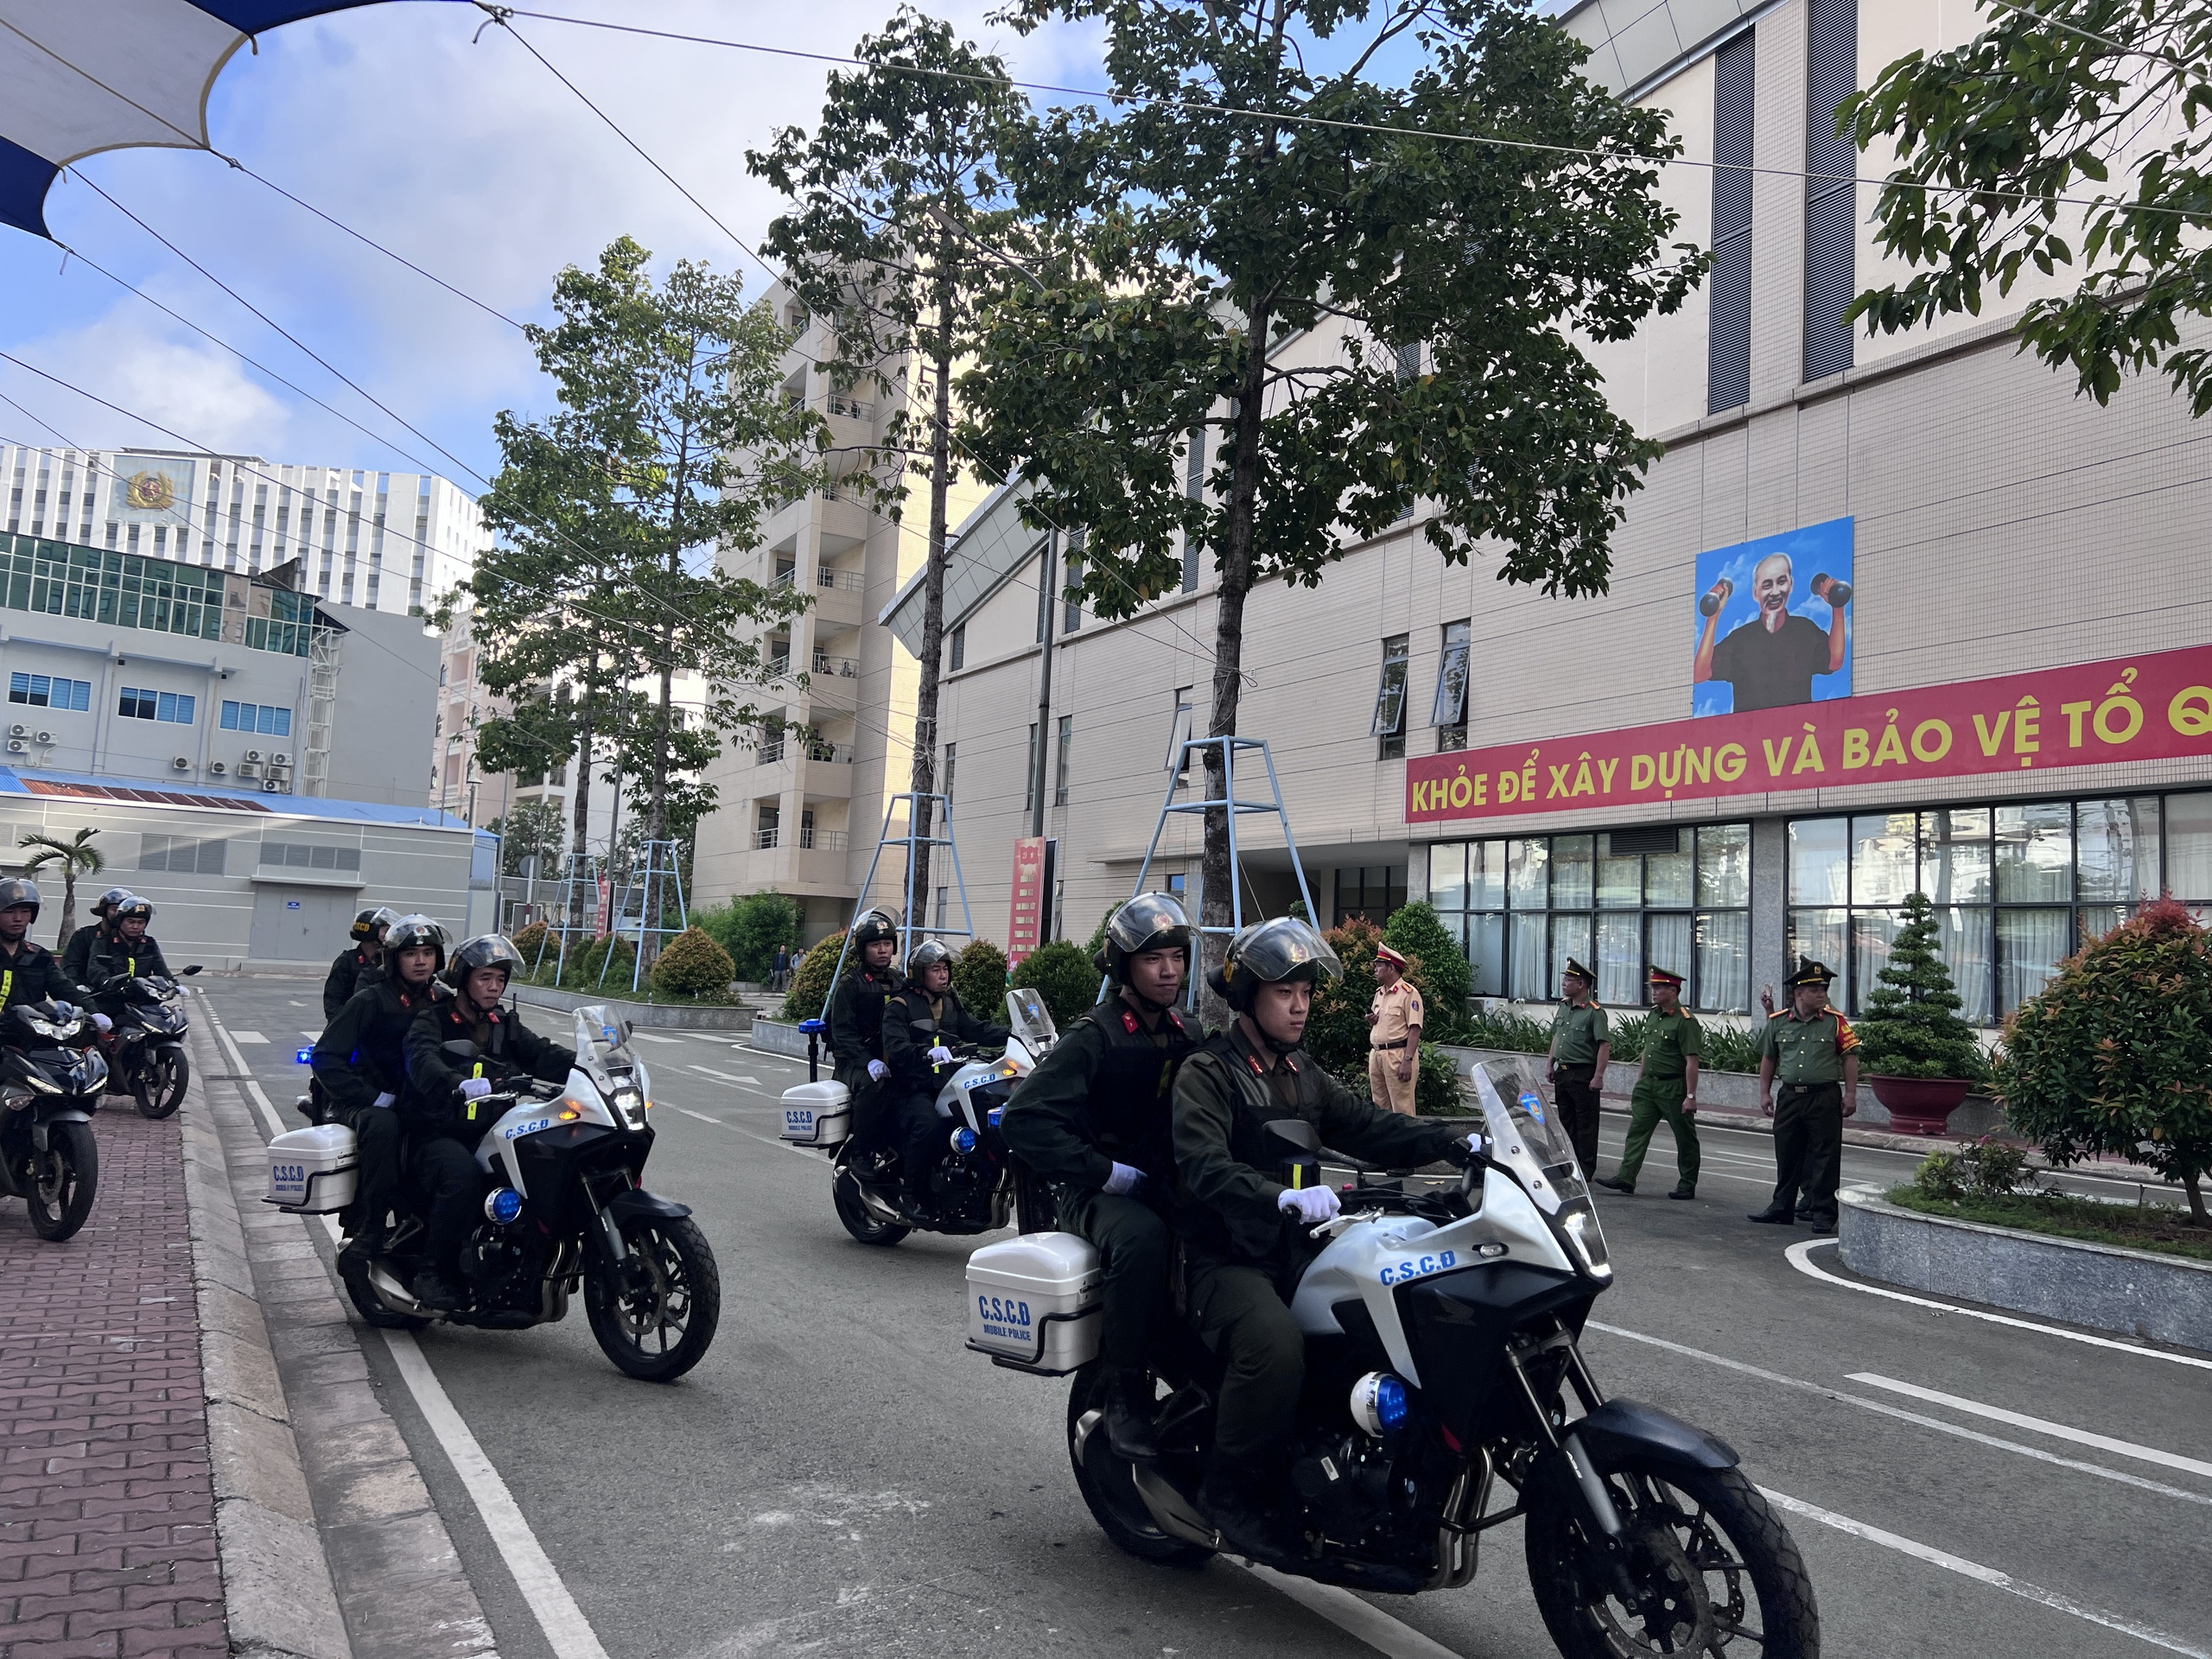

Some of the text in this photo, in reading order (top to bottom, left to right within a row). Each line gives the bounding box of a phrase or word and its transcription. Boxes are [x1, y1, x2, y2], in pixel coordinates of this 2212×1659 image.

[1411, 765, 1488, 812] KHỎE
[1497, 748, 1540, 802] ĐỂ
[1546, 751, 1619, 799] XÂY
[1630, 742, 1747, 798] DỰNG
[1763, 722, 1825, 777] VÀ
[1842, 708, 1953, 770] BẢO
[1973, 695, 2040, 767] VỆ
[2061, 666, 2144, 748] TỔ
[983, 1324, 1031, 1341] MOBILE POLICE
